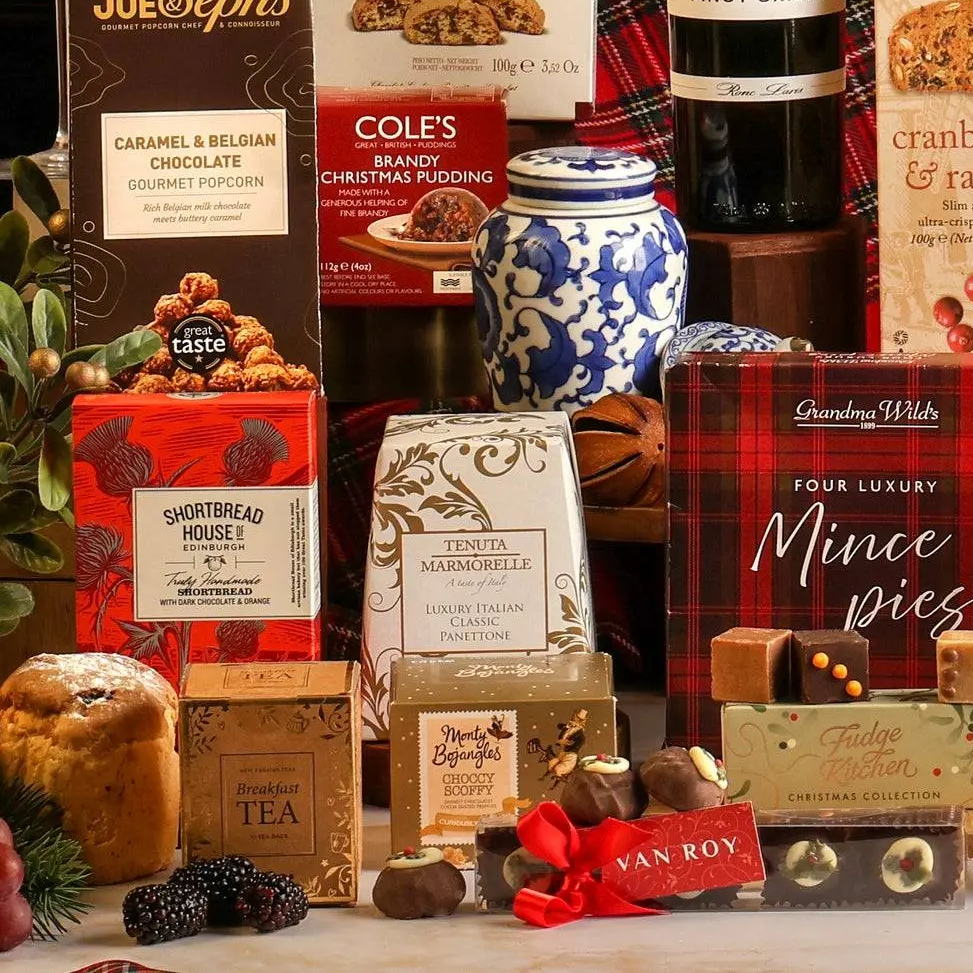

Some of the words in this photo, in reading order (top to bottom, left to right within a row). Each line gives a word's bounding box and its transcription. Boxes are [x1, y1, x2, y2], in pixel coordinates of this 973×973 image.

[142, 22, 179, 30] POPCORN
[182, 21, 202, 29] CHEF
[227, 20, 281, 28] CONNOISSEUR
[492, 58, 518, 76] 100g
[563, 59, 580, 74] Oz
[355, 115, 457, 140] COLE'S
[114, 135, 190, 151] CARAMEL
[193, 134, 205, 148] &
[208, 133, 276, 148] BELGIAN
[150, 155, 242, 170] CHOCOLATE
[374, 154, 440, 168] BRANDY
[321, 170, 412, 184] CHRISTMAS
[417, 170, 494, 184] PUDDING
[905, 161, 939, 190] &
[128, 177, 194, 191] GOURMET
[199, 176, 264, 189] POPCORN
[143, 203, 161, 212] Rich
[163, 202, 192, 214] Belgian
[194, 201, 212, 211] milk
[214, 201, 251, 211] chocolate
[153, 215, 177, 223] meets
[178, 213, 208, 224] buttery
[209, 212, 242, 222] caramel
[910, 232, 936, 247] 100g
[950, 232, 973, 245] (Net
[184, 325, 212, 339] great
[172, 338, 226, 354] taste
[793, 399, 876, 422] Grandma
[878, 399, 939, 422] Wild's
[860, 421, 875, 430] 1899
[794, 479, 847, 493] FOUR
[858, 479, 938, 494] LUXURY
[163, 501, 264, 526] SHORTBREAD
[183, 524, 233, 541] HOUSE
[236, 526, 244, 540] OF
[183, 544, 245, 552] EDINBURGH
[444, 538, 507, 552] TENUTA
[750, 501, 952, 588] Mince
[420, 558, 532, 573] MARMORELLE
[177, 587, 253, 596] SHORTBREAD
[160, 598, 177, 606] WITH
[178, 598, 196, 606] DARK
[197, 597, 236, 606] CHOCOLATE
[244, 597, 271, 605] ORANGE
[426, 602, 472, 614] LUXURY
[476, 602, 524, 614] ITALIAN
[450, 616, 500, 627] CLASSIC
[440, 630, 511, 642] PANETTONE
[441, 724, 487, 749] Monty
[819, 720, 903, 756] Fudge
[432, 744, 502, 769] Bojangles
[822, 748, 918, 787] Kitchen
[442, 773, 496, 784] CHOCCY
[236, 781, 299, 797] Breakfast
[444, 785, 494, 797] SCOFFY
[788, 792, 858, 803] CHRISTMAS
[863, 791, 942, 801] COLLECTION
[236, 800, 300, 826] TEA
[616, 848, 671, 873] VAN
[683, 835, 740, 861] ROY
